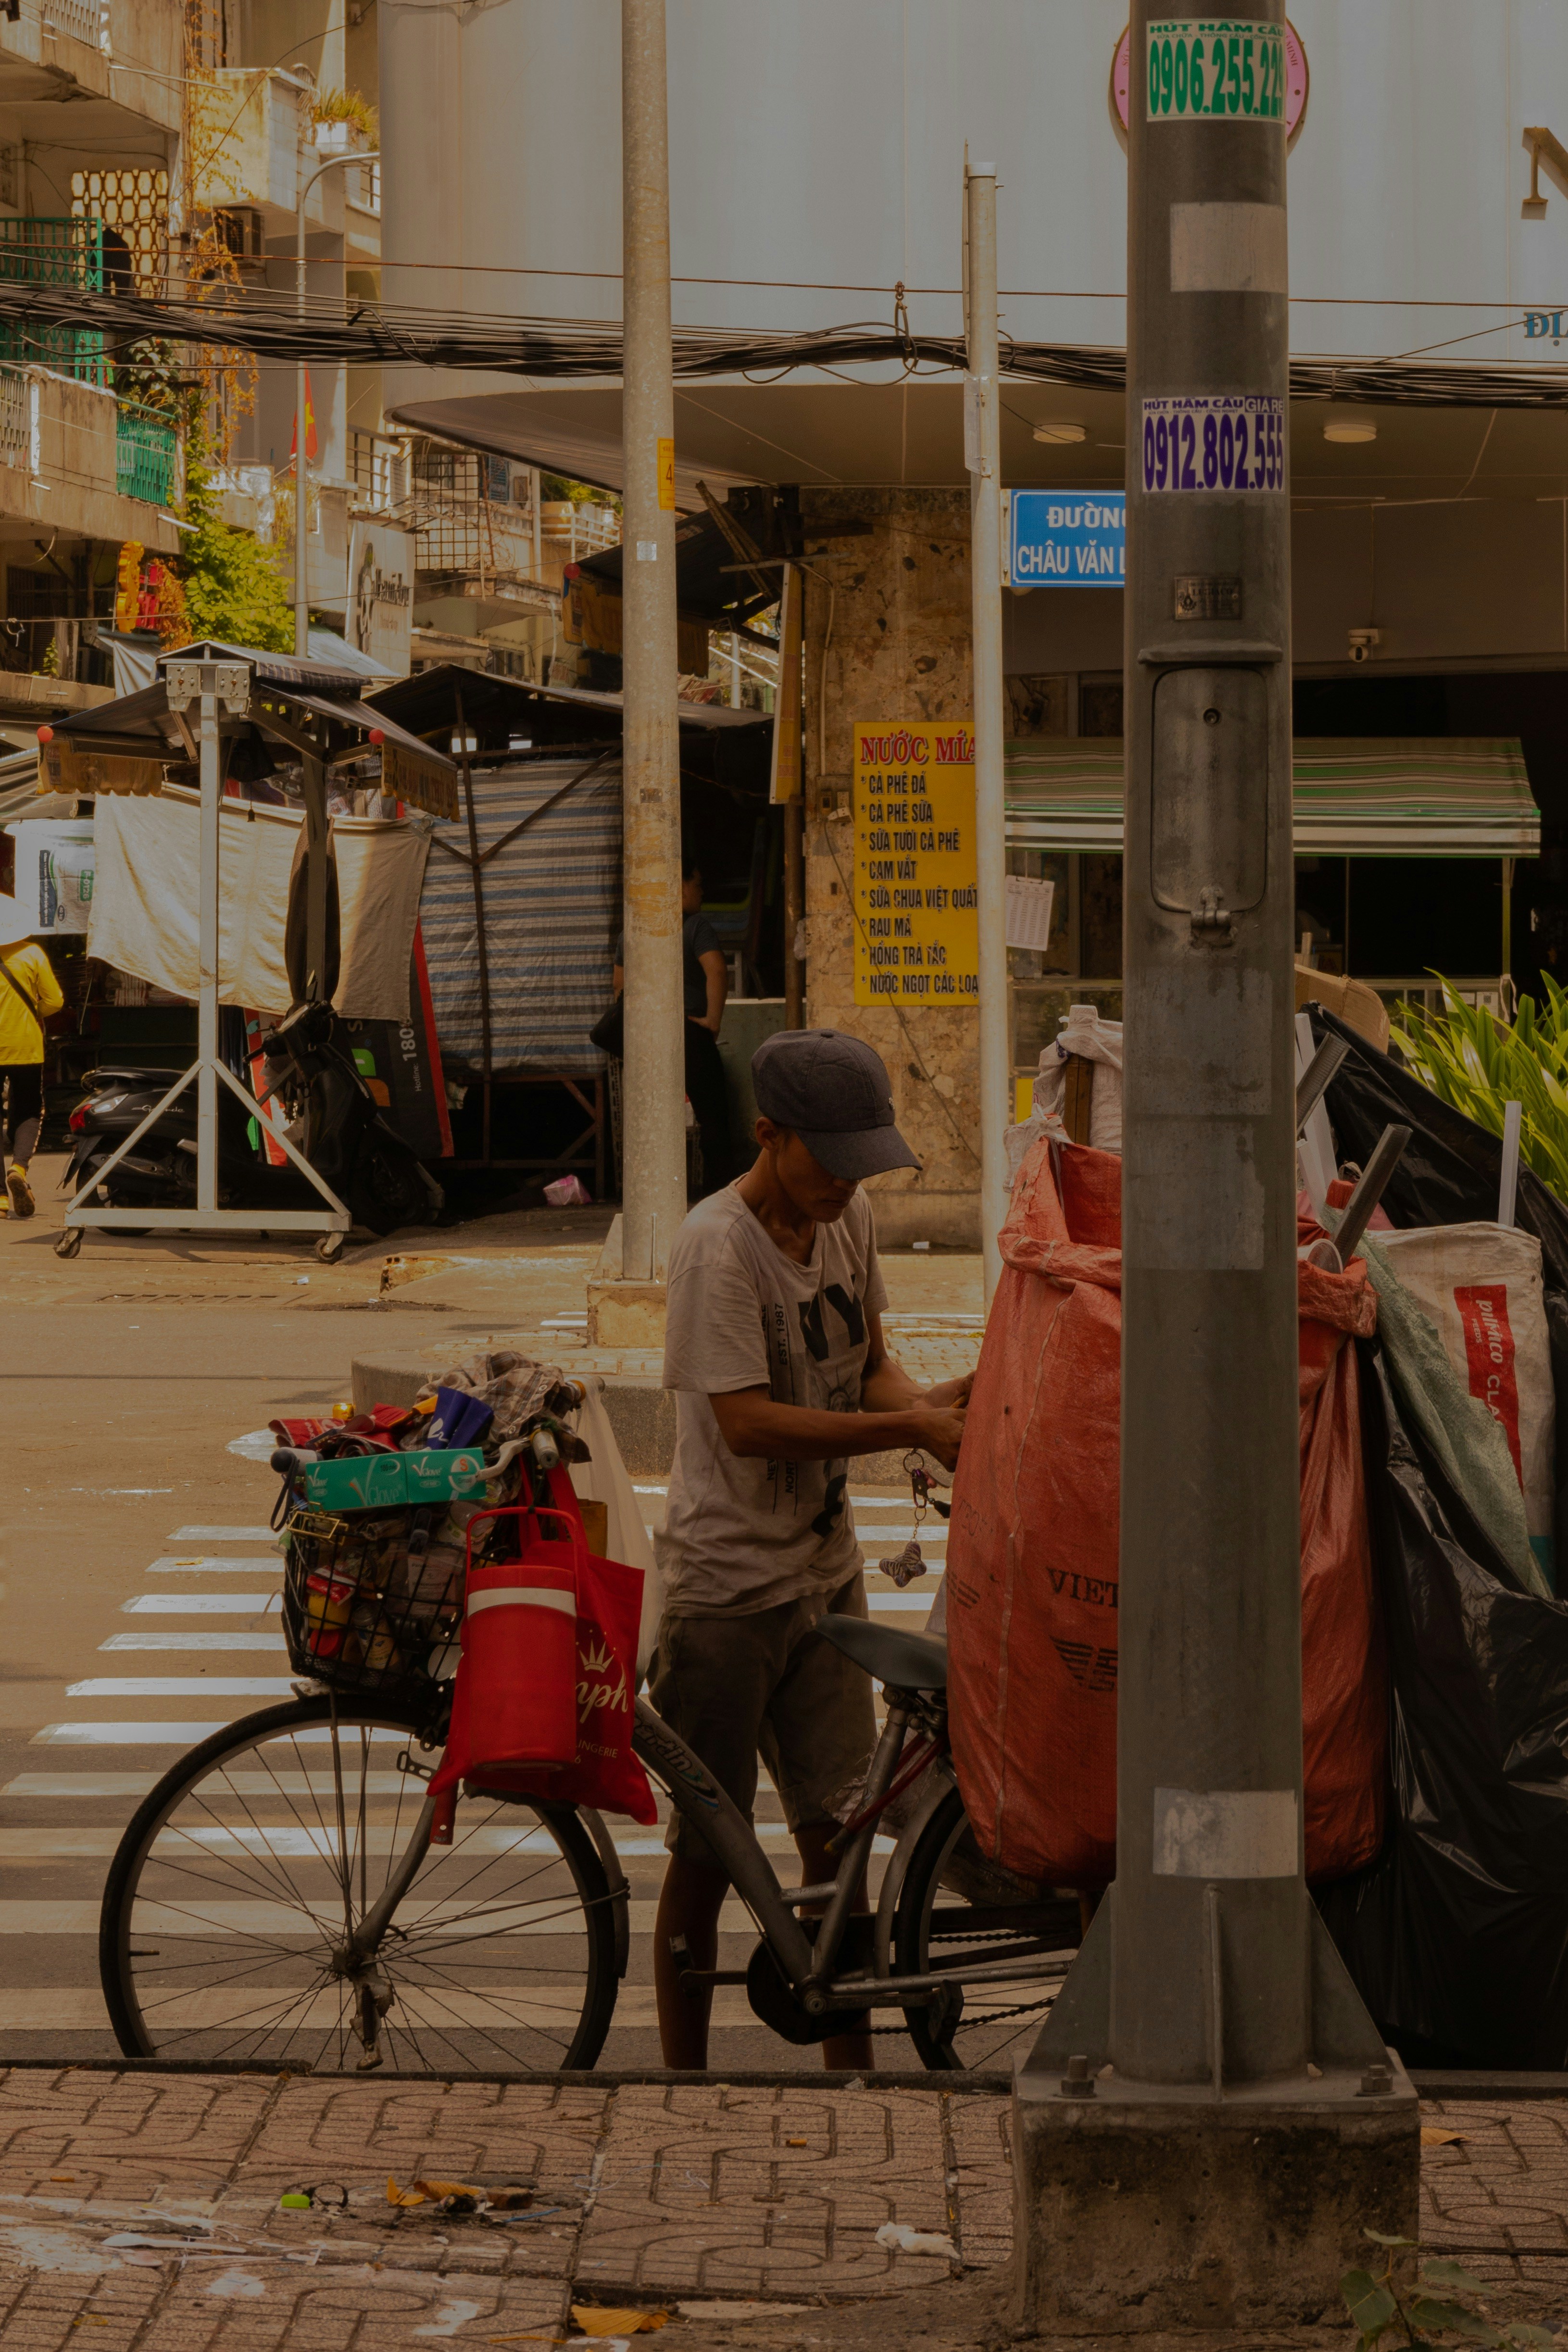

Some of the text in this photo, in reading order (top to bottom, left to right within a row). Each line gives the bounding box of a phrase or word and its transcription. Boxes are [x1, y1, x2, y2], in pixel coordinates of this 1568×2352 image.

[1523, 312, 1568, 346] ĐỊ
[1144, 415, 1283, 491] 0912.802.555
[1046, 502, 1126, 528] ĐƯỜN
[1018, 540, 1069, 573] CHÂU
[1075, 540, 1114, 574] VĂN
[860, 729, 928, 764] NƯỚC
[869, 770, 927, 794] CÀ PHÊ ĐÁ
[869, 799, 934, 823] CÀ PHÊ SỮA
[869, 828, 960, 852] SỮA TƯƠI CÀ PHÊ
[869, 854, 917, 880] CAM VẮT
[869, 885, 891, 909] SỮA
[893, 889, 923, 909] CHUA
[926, 885, 949, 913] VIỆT
[869, 914, 912, 937] RAU MÁ
[869, 939, 947, 966] HỒNG TRÀ TẮC
[870, 970, 899, 994] NƯỚC
[903, 974, 931, 998] NGỌT
[934, 970, 955, 994] CÁC
[413, 1063, 422, 1092] Hotline:
[774, 1303, 788, 1365] EST. 1987
[1472, 1318, 1482, 1343] FEEDS
[460, 1458, 468, 1472] S
[576, 1739, 618, 1758] INGERIE
